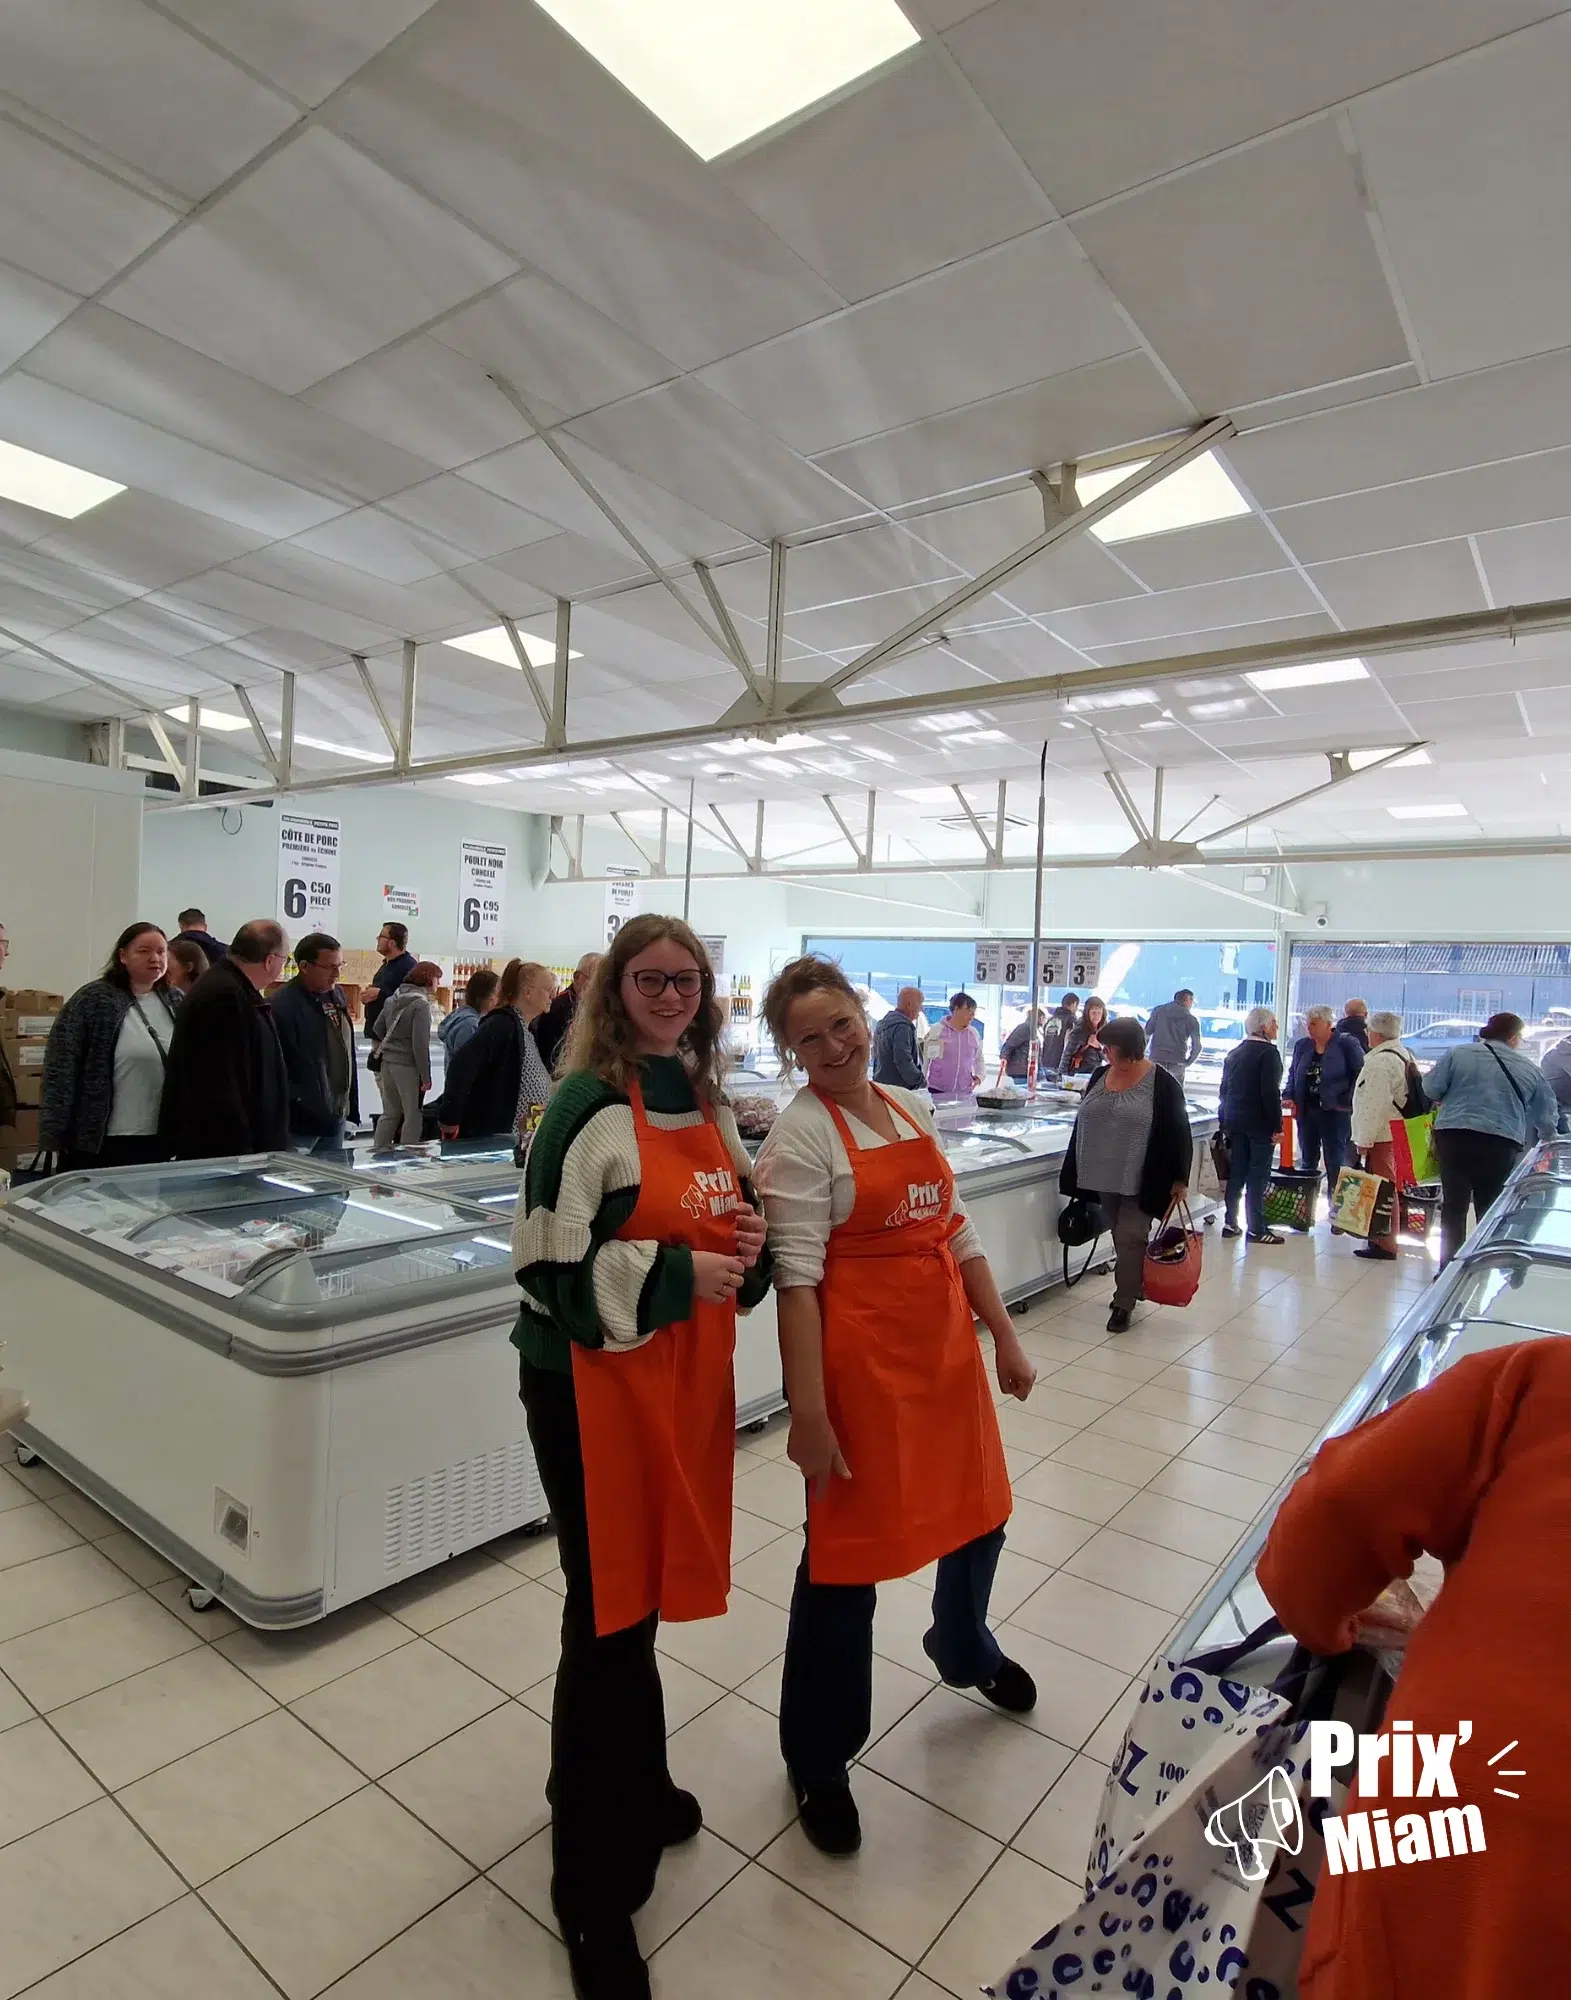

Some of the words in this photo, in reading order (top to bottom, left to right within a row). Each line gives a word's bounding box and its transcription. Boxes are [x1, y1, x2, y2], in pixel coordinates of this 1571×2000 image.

[282, 828, 303, 842] CÔTE
[304, 832, 314, 844] DE
[316, 835, 338, 847] PORC
[464, 855, 487, 867] POULET
[488, 858, 504, 869] NOIR
[284, 878, 306, 918] 6
[310, 881, 331, 895] €50
[310, 894, 331, 906] PIÈCE
[463, 897, 480, 933] 6
[483, 900, 499, 912] €95
[607, 914, 620, 943] 3
[977, 962, 987, 981] 5
[1005, 963, 1016, 982] 8
[1043, 964, 1054, 984] 5
[1073, 965, 1085, 985] 3
[693, 1167, 734, 1193] Prix
[709, 1193, 739, 1217] Miam
[1159, 1761, 1191, 1783] 100
